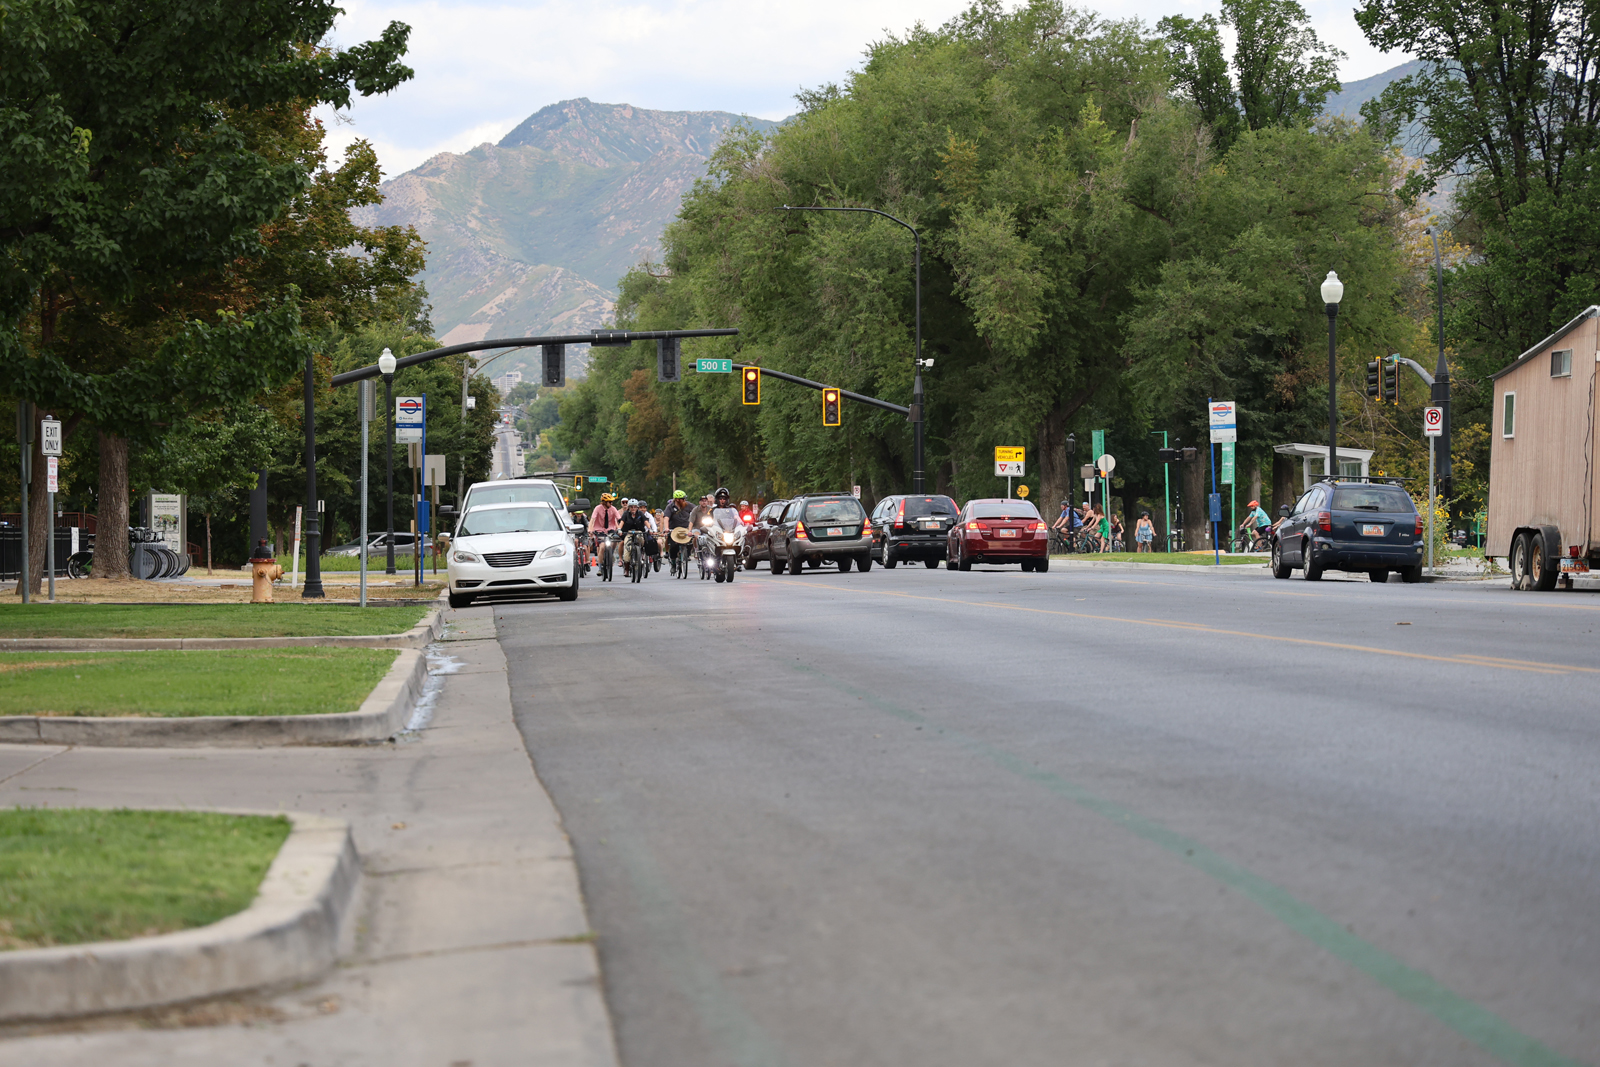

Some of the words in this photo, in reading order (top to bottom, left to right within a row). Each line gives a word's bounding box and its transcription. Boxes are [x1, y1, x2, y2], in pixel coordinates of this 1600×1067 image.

[701, 361, 718, 371] 500
[722, 361, 728, 371] E
[45, 426, 58, 438] EXIT
[45, 439, 60, 451] ONLY
[1017, 486, 1023, 496] 9
